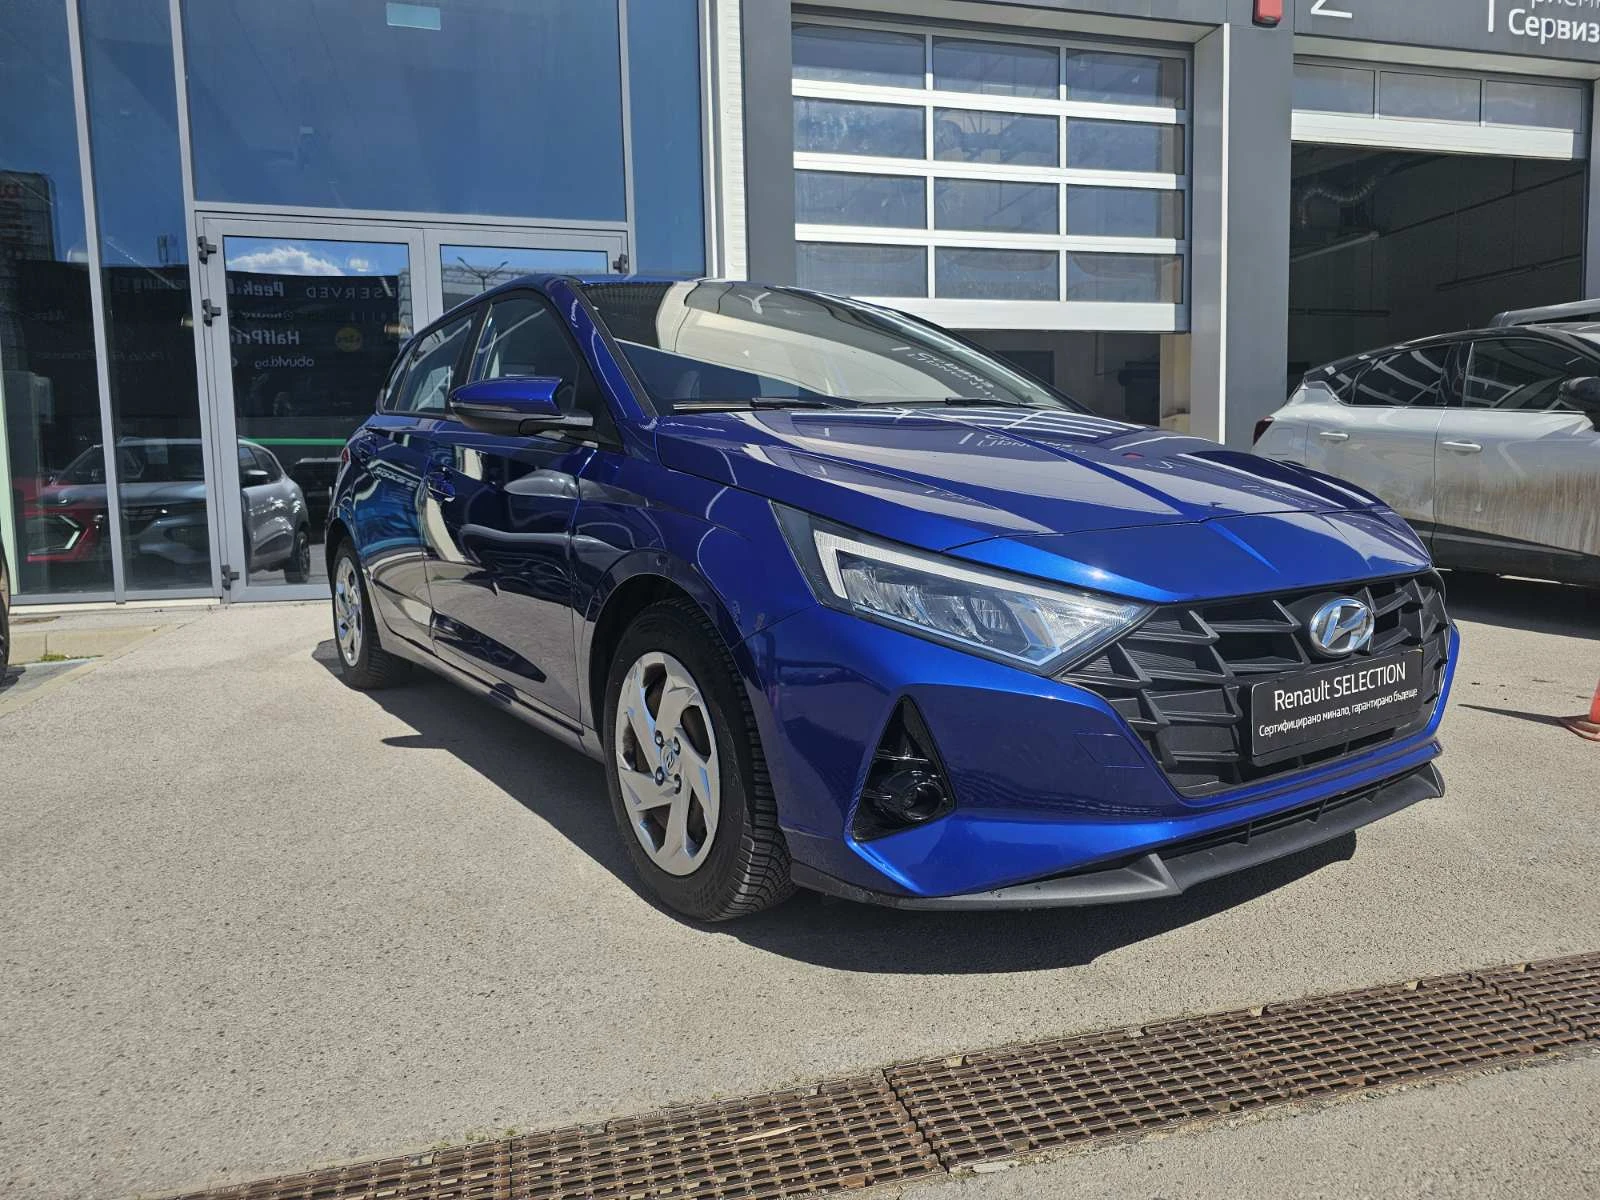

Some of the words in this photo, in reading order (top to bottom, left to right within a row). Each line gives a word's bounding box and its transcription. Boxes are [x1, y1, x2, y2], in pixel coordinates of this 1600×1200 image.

[1507, 8, 1600, 45] Сервиз
[1274, 679, 1331, 712] Renault
[1333, 662, 1406, 697] SELECTION
[1259, 713, 1322, 738] Сертифицирано
[1322, 706, 1351, 721] минало,
[1351, 695, 1393, 715] гарантирано
